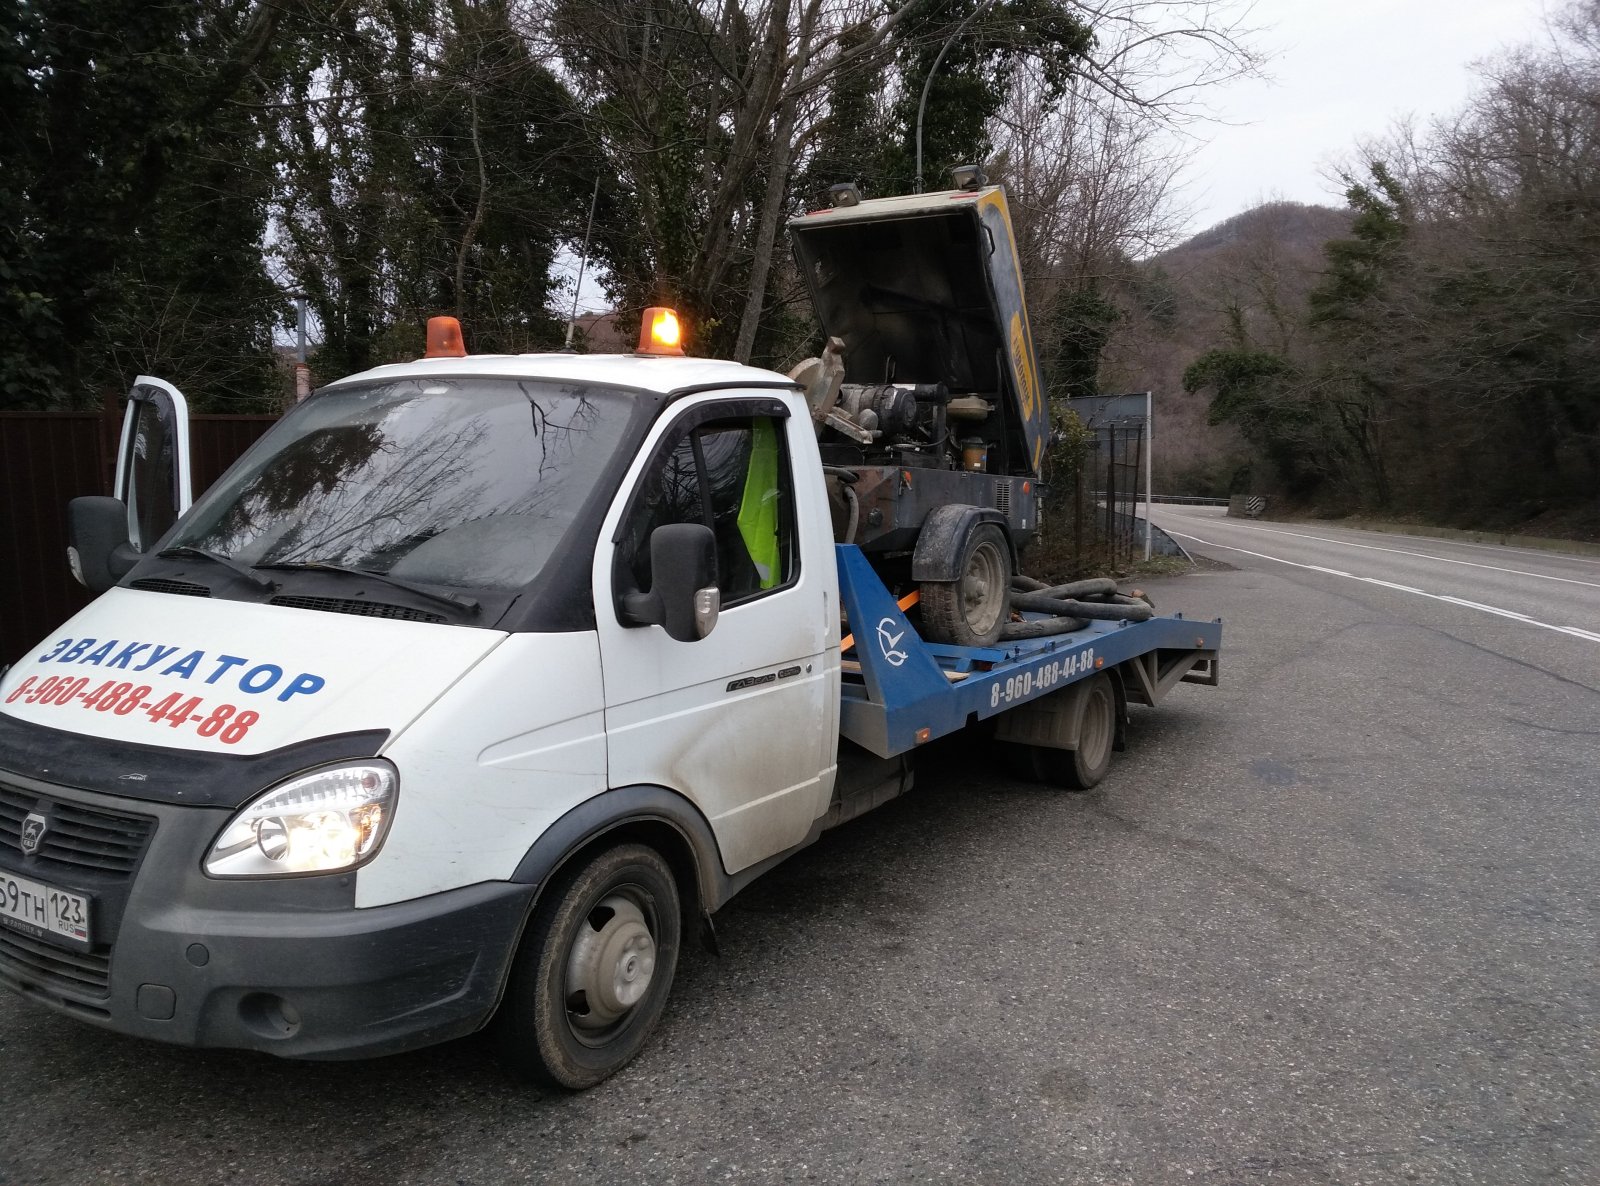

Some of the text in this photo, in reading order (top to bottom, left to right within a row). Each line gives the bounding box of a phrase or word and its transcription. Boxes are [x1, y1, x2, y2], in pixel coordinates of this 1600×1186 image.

[38, 638, 326, 702] ЭВАКУАТОР
[990, 647, 1094, 708] 8-960-488-44-88
[6, 675, 260, 745] 8-960-488-44-88
[50, 892, 81, 924] 123
[58, 920, 75, 934] RUS
